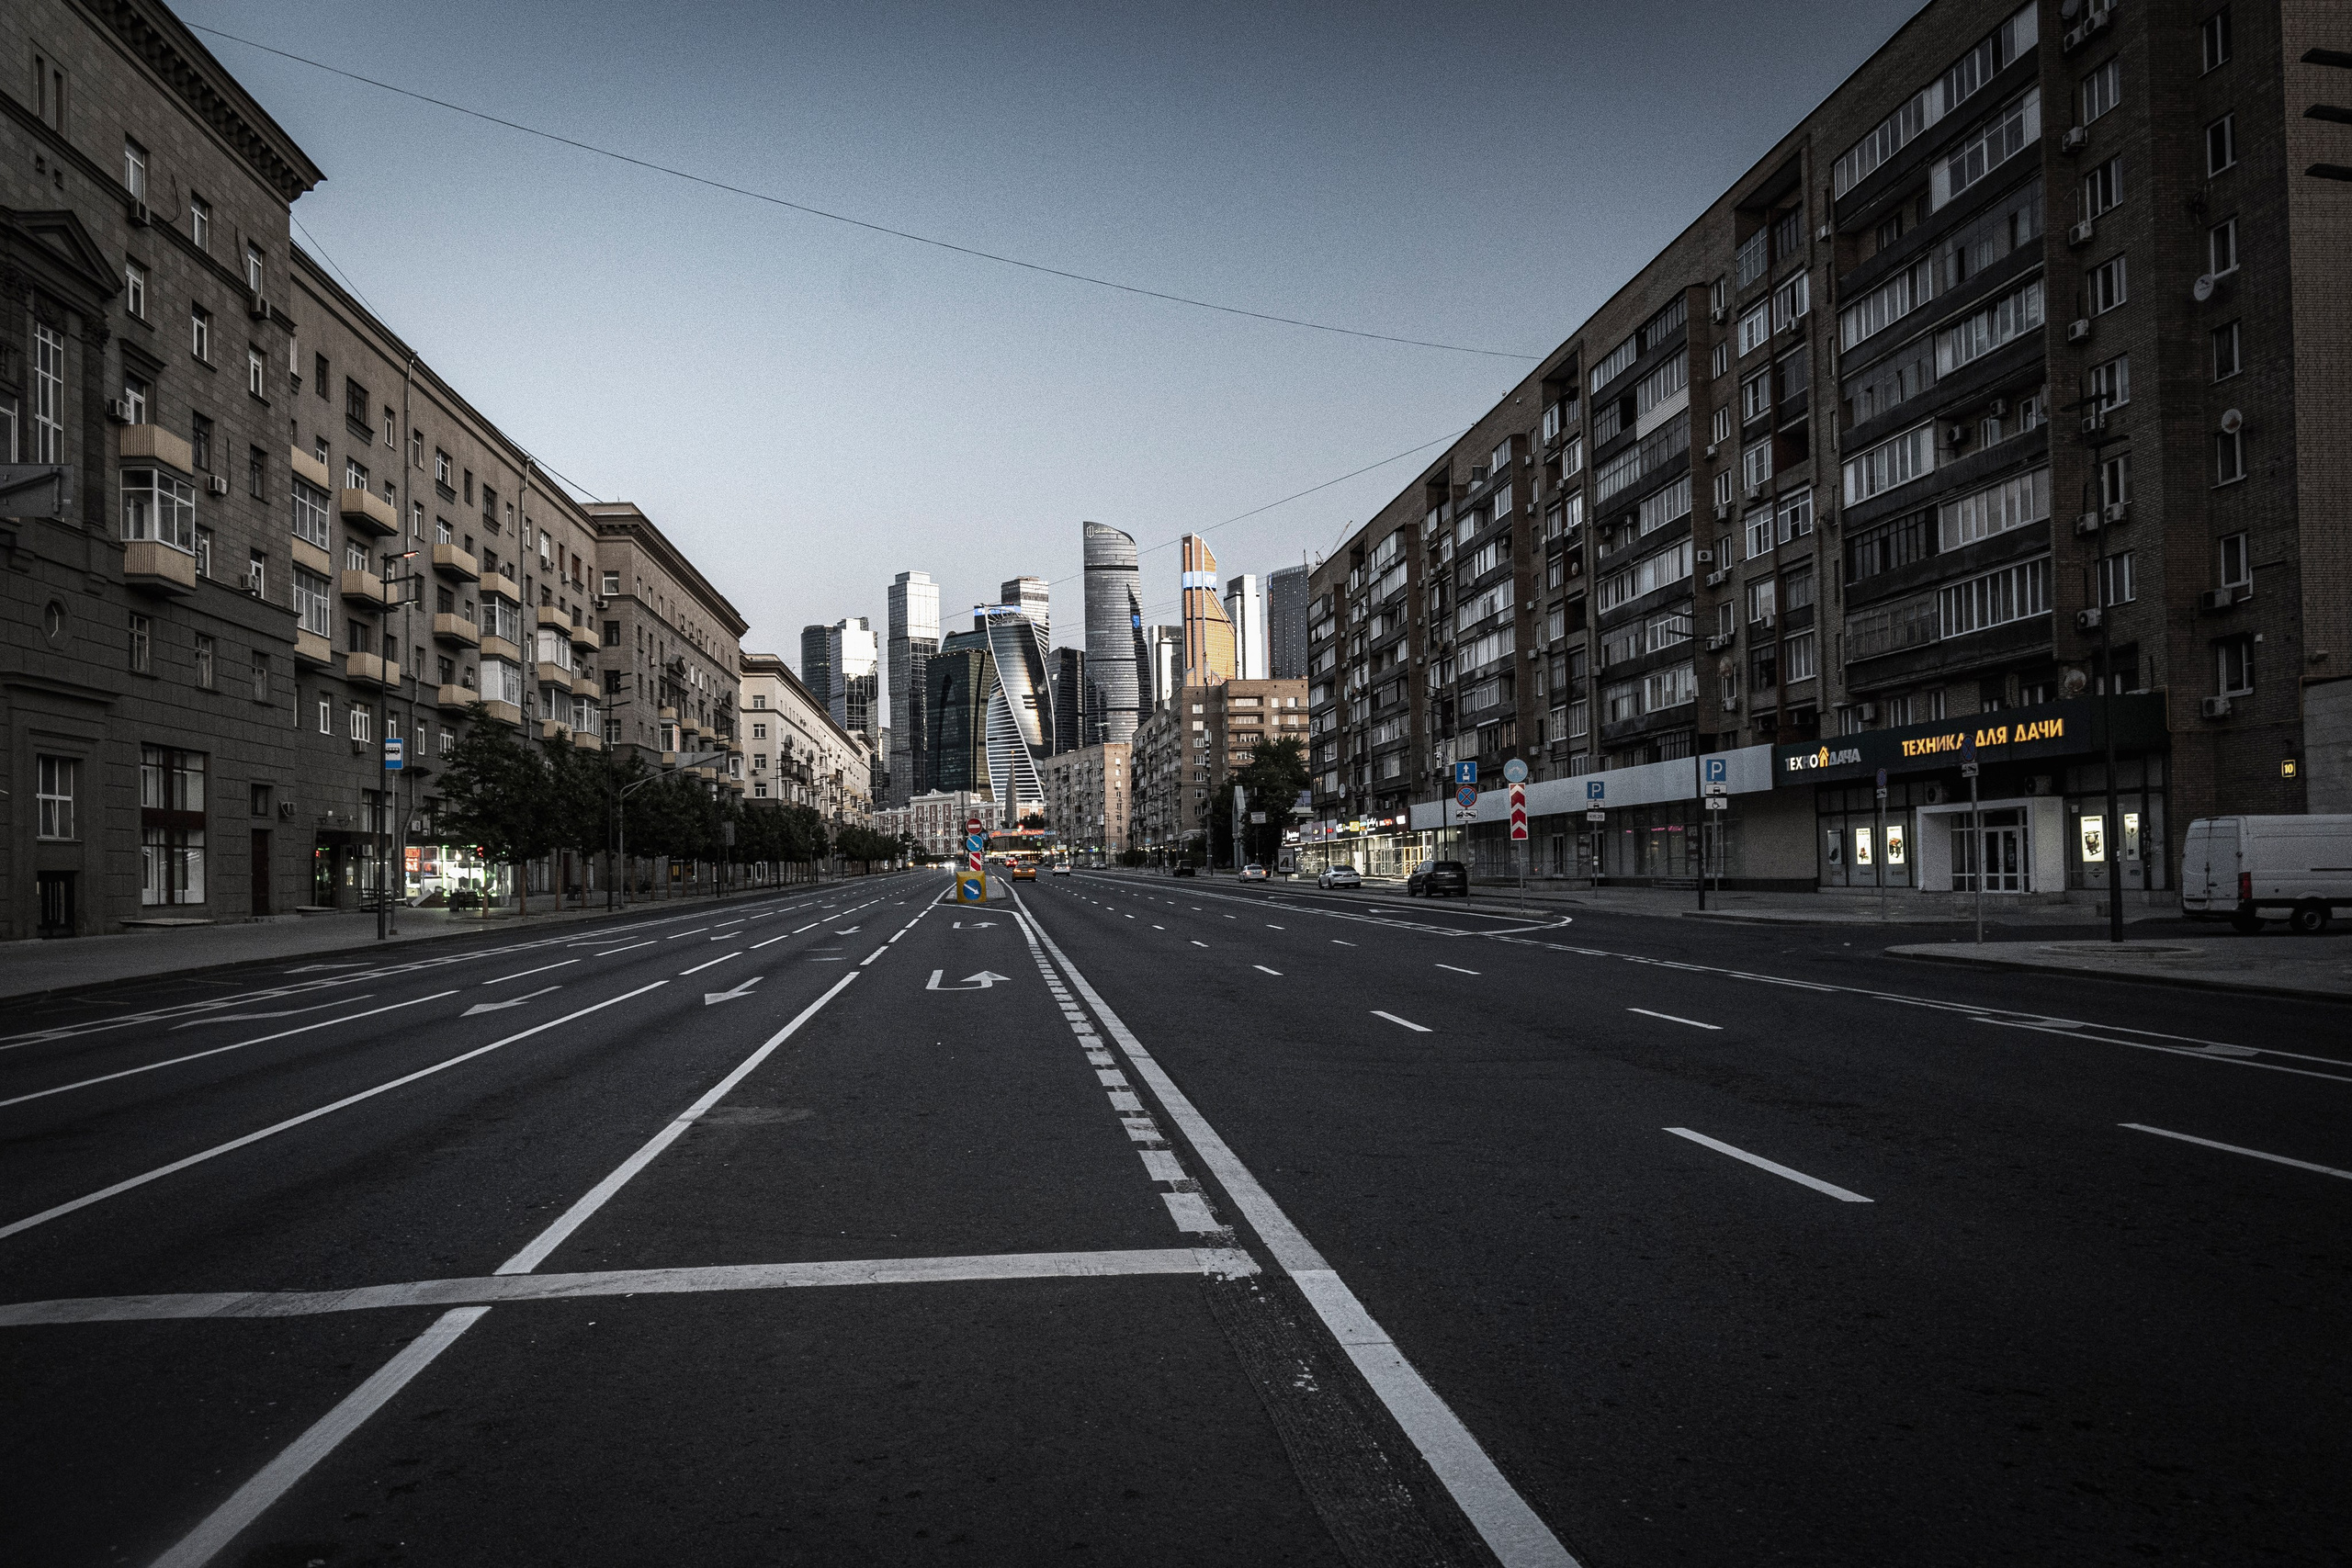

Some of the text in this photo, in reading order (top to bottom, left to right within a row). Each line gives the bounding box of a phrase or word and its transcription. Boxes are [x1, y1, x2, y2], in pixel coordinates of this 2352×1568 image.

[1902, 718, 2064, 757] ТЕХНИКА ДЛЯ ДАЧИ
[1711, 761, 1723, 780] P
[2284, 763, 2294, 774] 10
[1591, 783, 1601, 798] P
